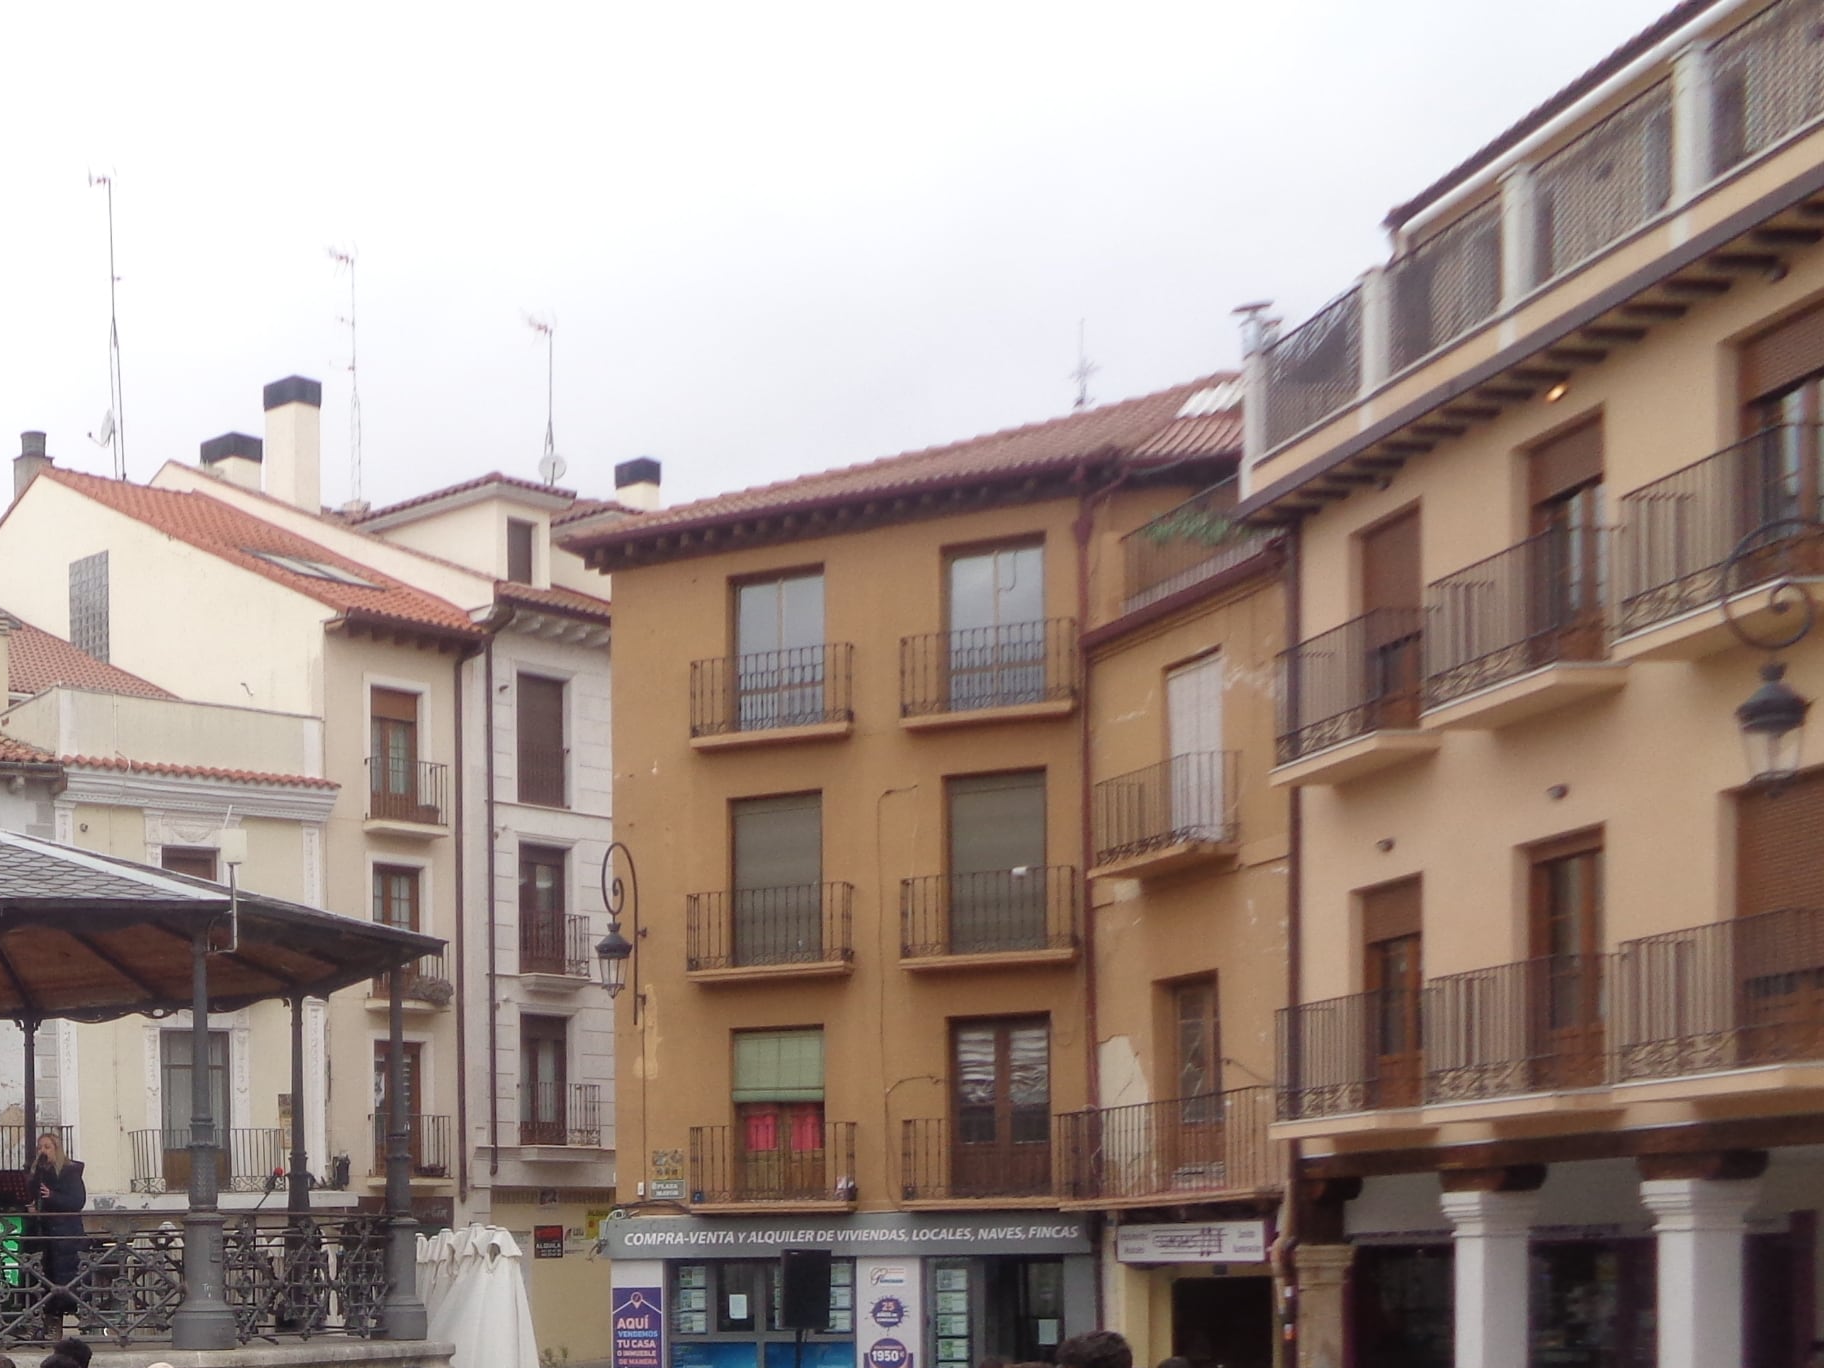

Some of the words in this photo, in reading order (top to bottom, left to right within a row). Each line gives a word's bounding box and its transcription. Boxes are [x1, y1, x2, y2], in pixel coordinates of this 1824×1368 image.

[624, 1231, 734, 1246] COMPRA-VENTA
[737, 1231, 749, 1243] Y
[748, 1230, 814, 1244] ALQUILER
[816, 1229, 836, 1242] DE
[837, 1229, 909, 1242] VIVIENDAS,
[911, 1228, 976, 1242] LOCALES,
[977, 1227, 1026, 1241] NAVES,
[1028, 1226, 1079, 1239] FINCAS
[617, 1315, 648, 1329] AQUÍ
[617, 1340, 630, 1349] TU
[631, 1340, 656, 1348] CASA
